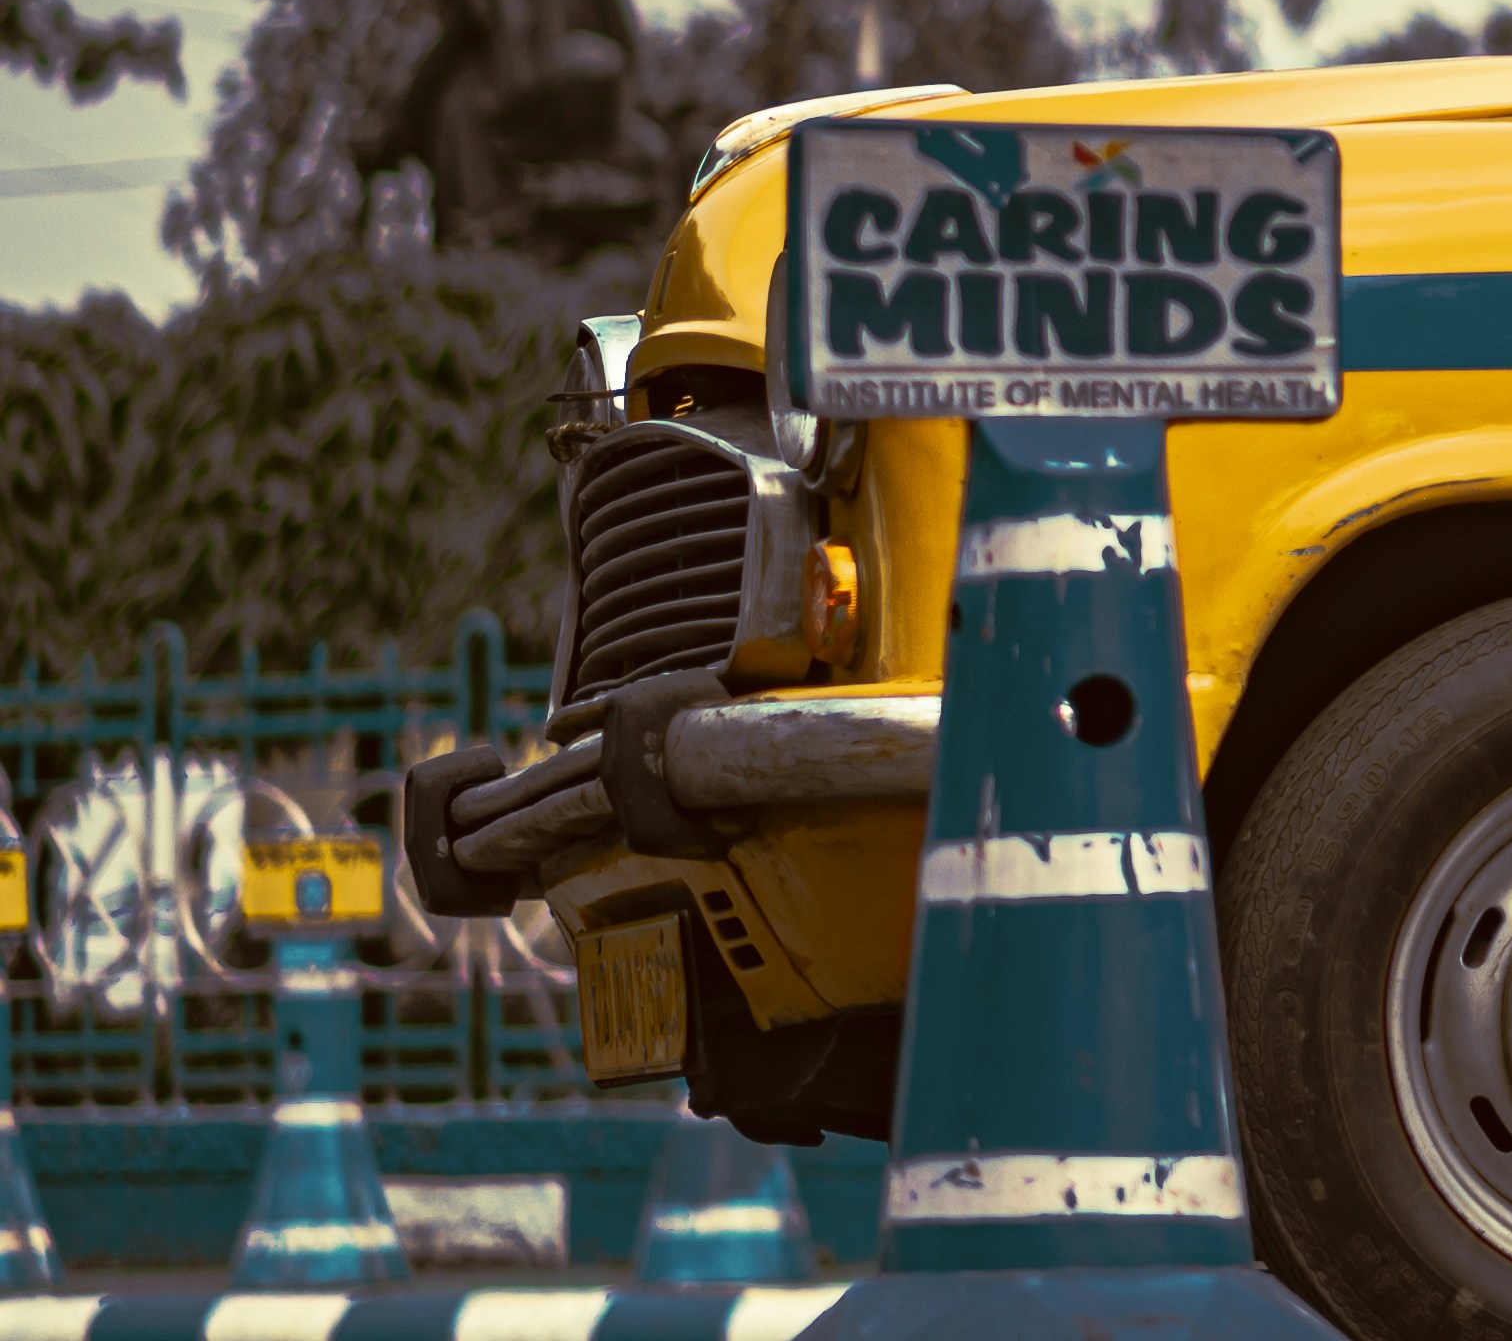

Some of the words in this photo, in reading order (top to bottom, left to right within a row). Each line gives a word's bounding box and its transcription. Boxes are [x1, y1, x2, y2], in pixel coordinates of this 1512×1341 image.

[823, 188, 1315, 265] CARING
[825, 268, 1316, 360] MINDS
[825, 379, 997, 409] INSTITUTE
[1005, 379, 1052, 409] OF
[1060, 379, 1194, 409] MENTAL
[1201, 379, 1328, 409] HEALTH
